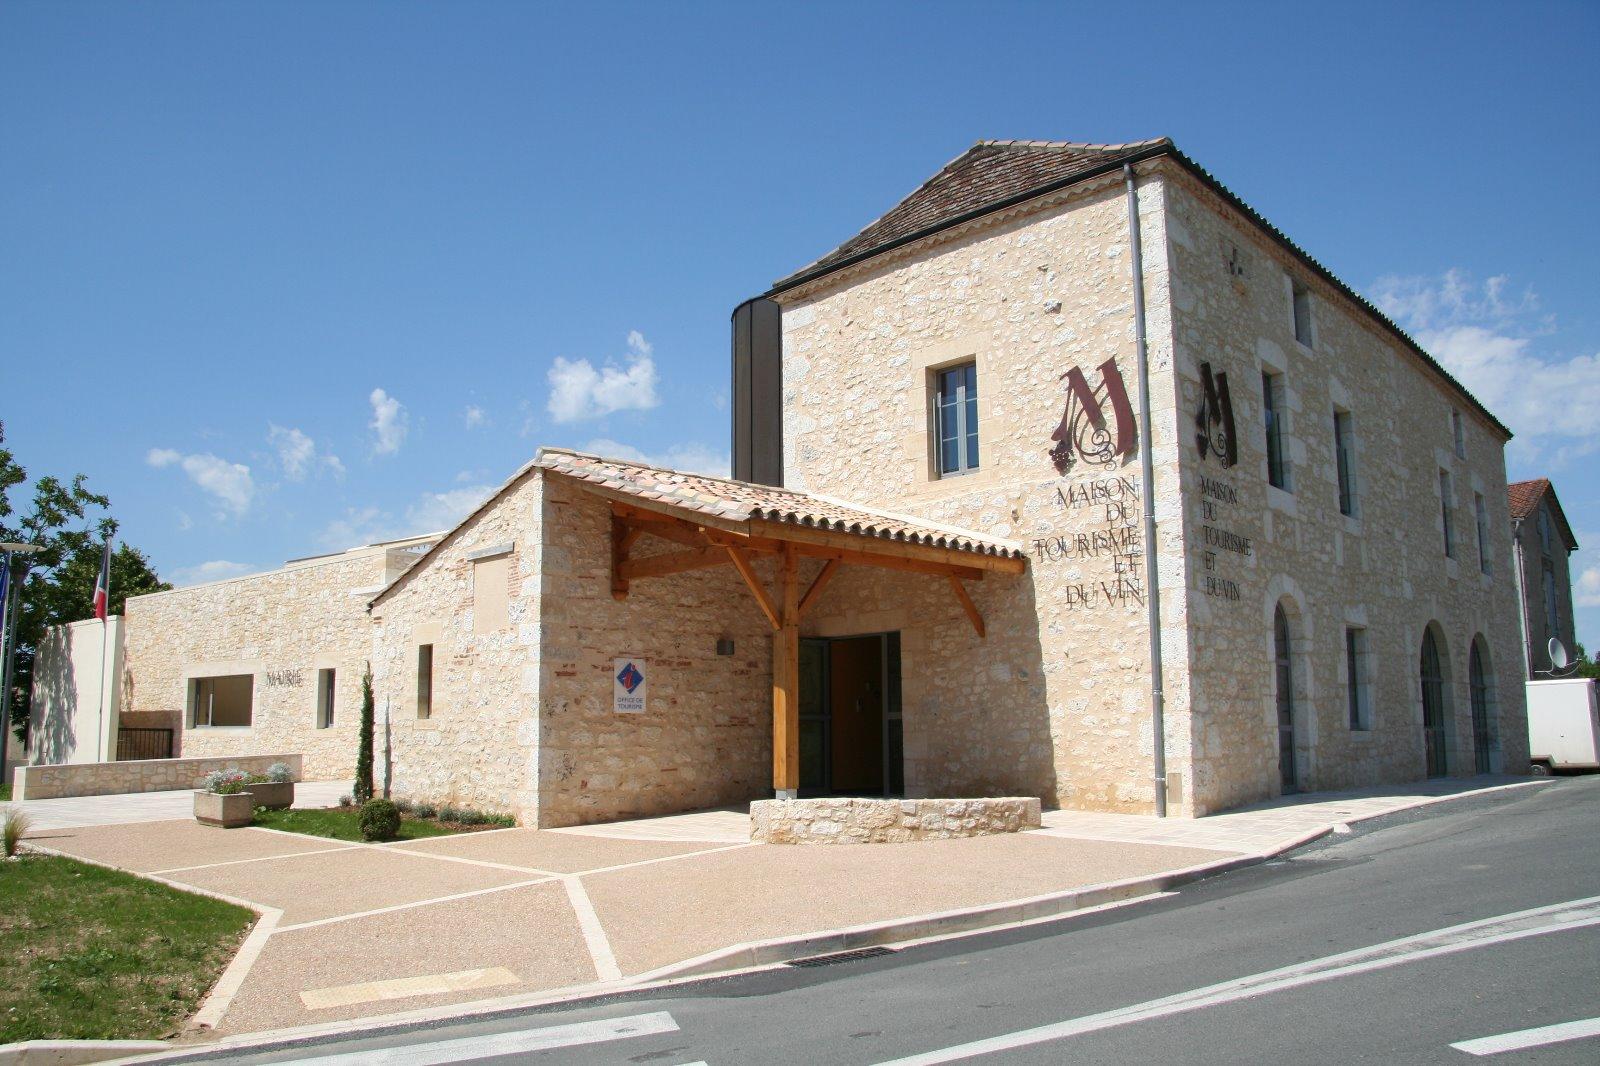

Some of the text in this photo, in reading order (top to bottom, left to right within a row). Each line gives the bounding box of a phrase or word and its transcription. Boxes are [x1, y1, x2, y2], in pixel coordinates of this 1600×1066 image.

[1057, 475, 1137, 509] MAISON
[1200, 475, 1238, 505] MAISON
[1106, 499, 1137, 522] DU
[1202, 500, 1217, 521] DU
[1033, 526, 1139, 557] TOURISME
[1203, 525, 1252, 557] TOURISME
[1113, 553, 1139, 574] ET
[1205, 551, 1216, 571] ET
[1066, 579, 1141, 607] DU VIN
[1206, 576, 1240, 600] DU VIN
[266, 669, 302, 687] MAIRIE
